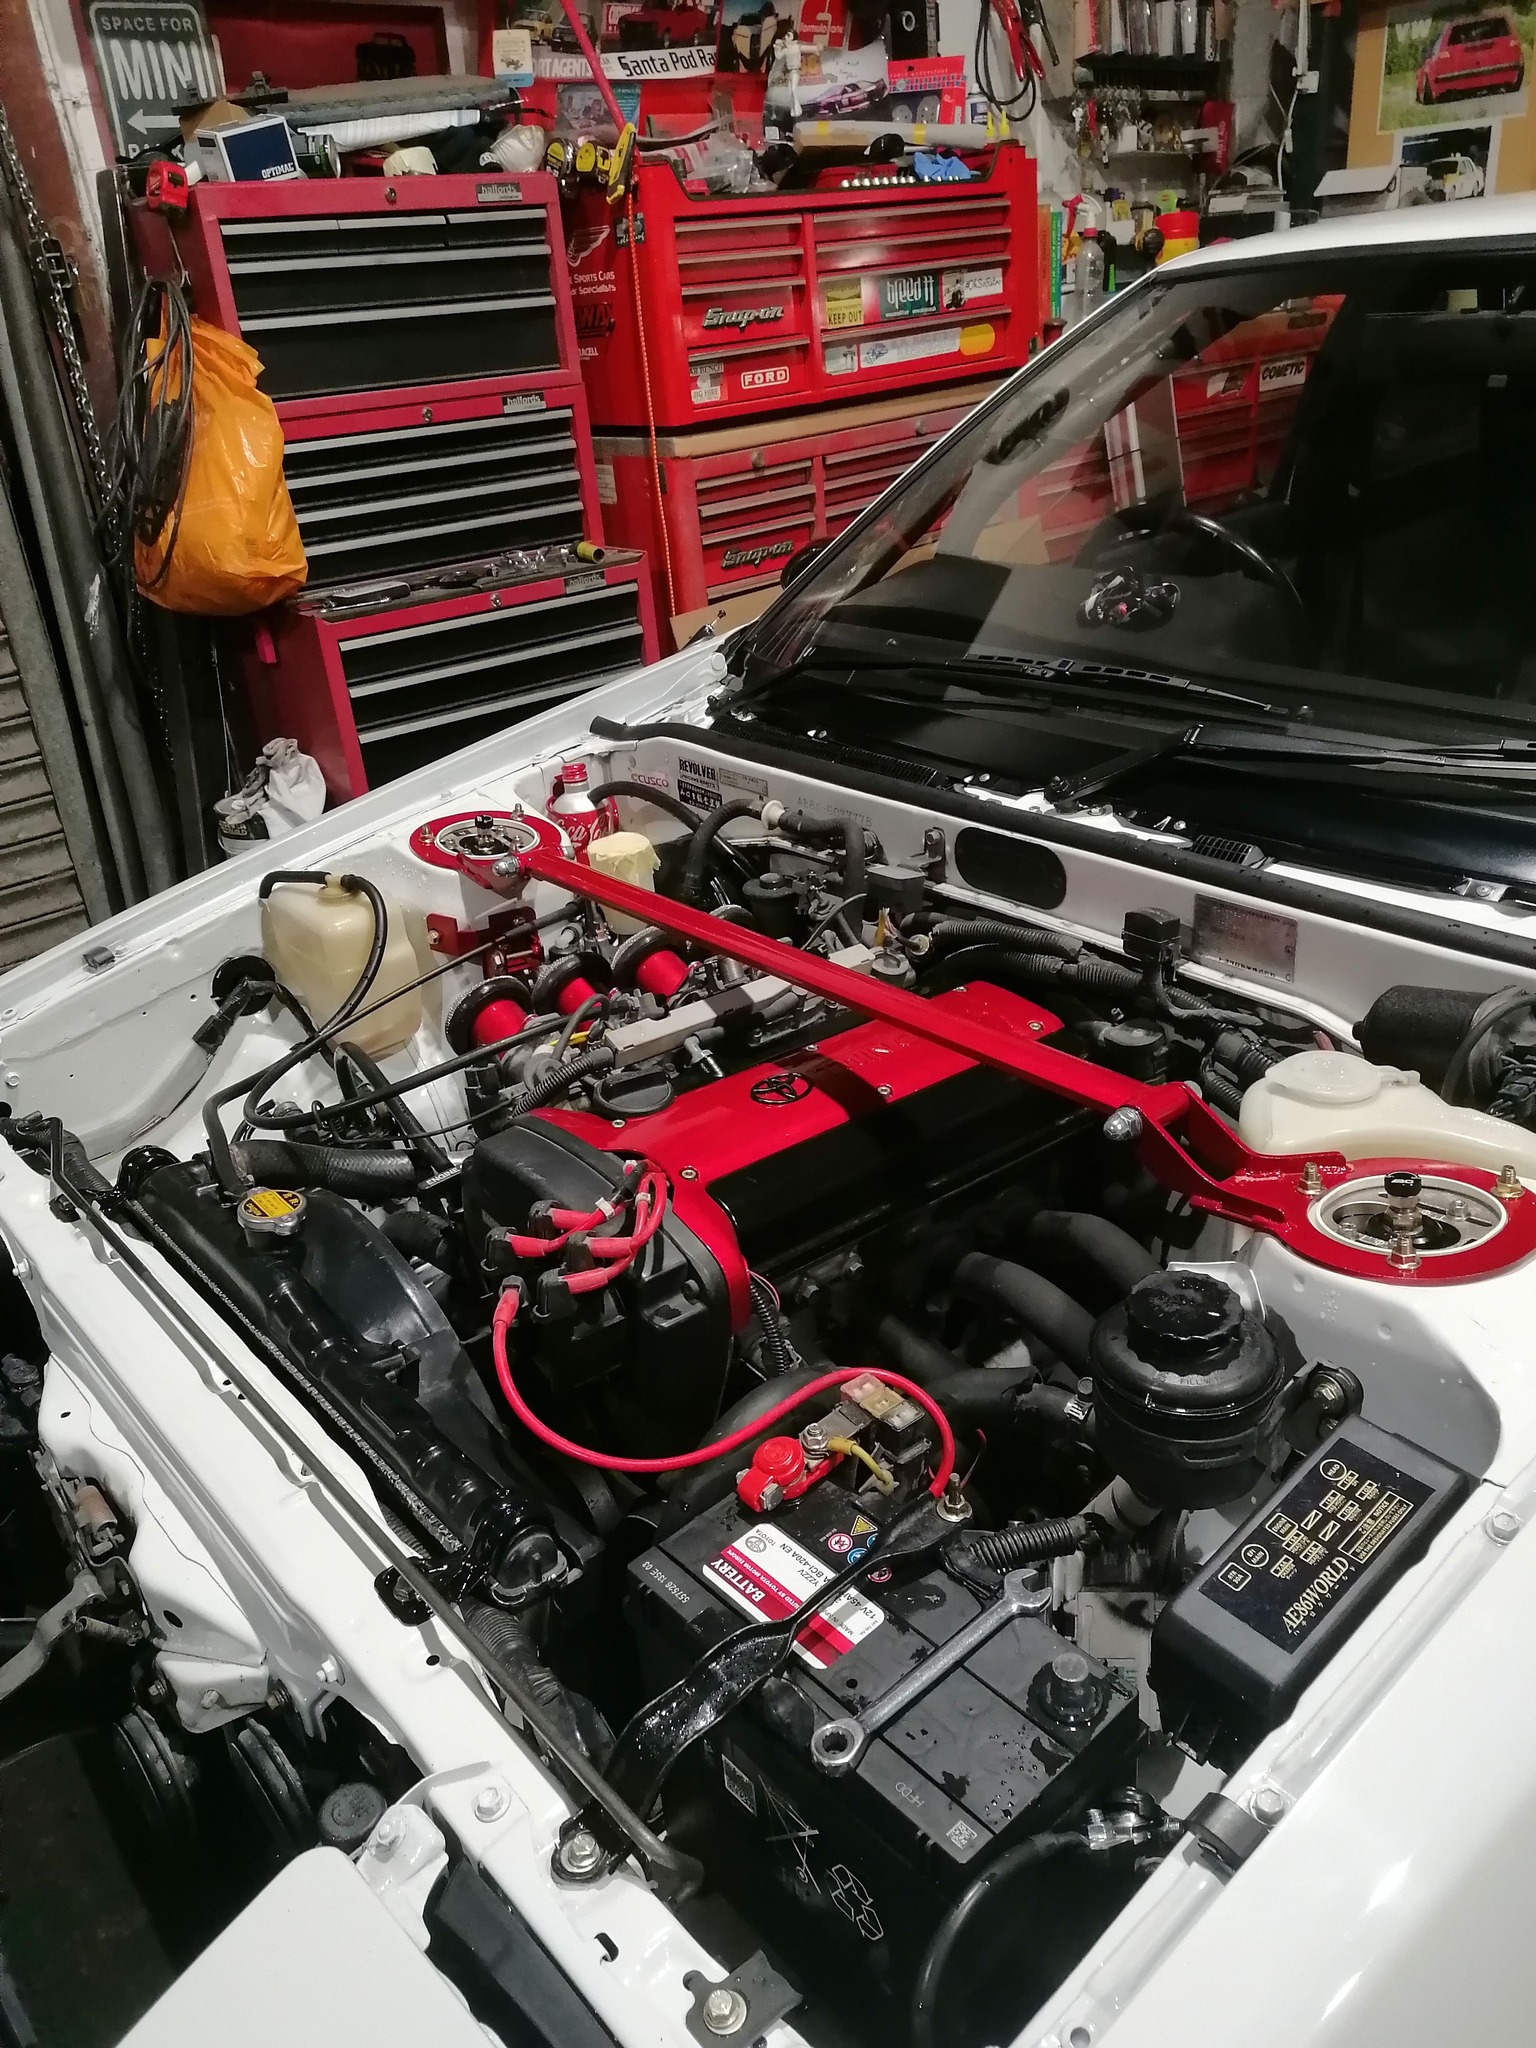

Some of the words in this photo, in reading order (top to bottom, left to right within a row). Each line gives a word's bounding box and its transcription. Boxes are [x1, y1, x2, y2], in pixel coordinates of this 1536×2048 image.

[101, 17, 156, 32] SPACE
[159, 17, 194, 32] FOR
[110, 39, 208, 100] MINI
[617, 53, 670, 78] Santa
[669, 50, 697, 70] Pod
[481, 183, 517, 195] halfords
[702, 306, 784, 328] Snap-on
[828, 312, 846, 326] KEEP
[848, 310, 863, 323] OUT
[744, 370, 786, 386] FORD
[507, 393, 541, 406] halfords
[679, 758, 718, 782] REVOLVER
[425, 1166, 460, 1185] ENGINE
[1327, 1463, 1340, 1476] HEAD
[1343, 1505, 1353, 1515] 10A
[1373, 1500, 1389, 1517] NOTICE
[755, 1528, 776, 1546] TOYOTA
[779, 1542, 792, 1553] EN
[726, 1549, 744, 1564] EUROPE
[791, 1550, 823, 1578] BCI-420A
[743, 1562, 761, 1576] MOTOR
[710, 1557, 765, 1602] BATTERY
[759, 1575, 778, 1591] TOYOTA
[1232, 1574, 1243, 1584] 30A
[1279, 1553, 1351, 1633] AE86WORLD
[859, 1606, 876, 1619] 12V
[838, 1621, 854, 1635] MADE
